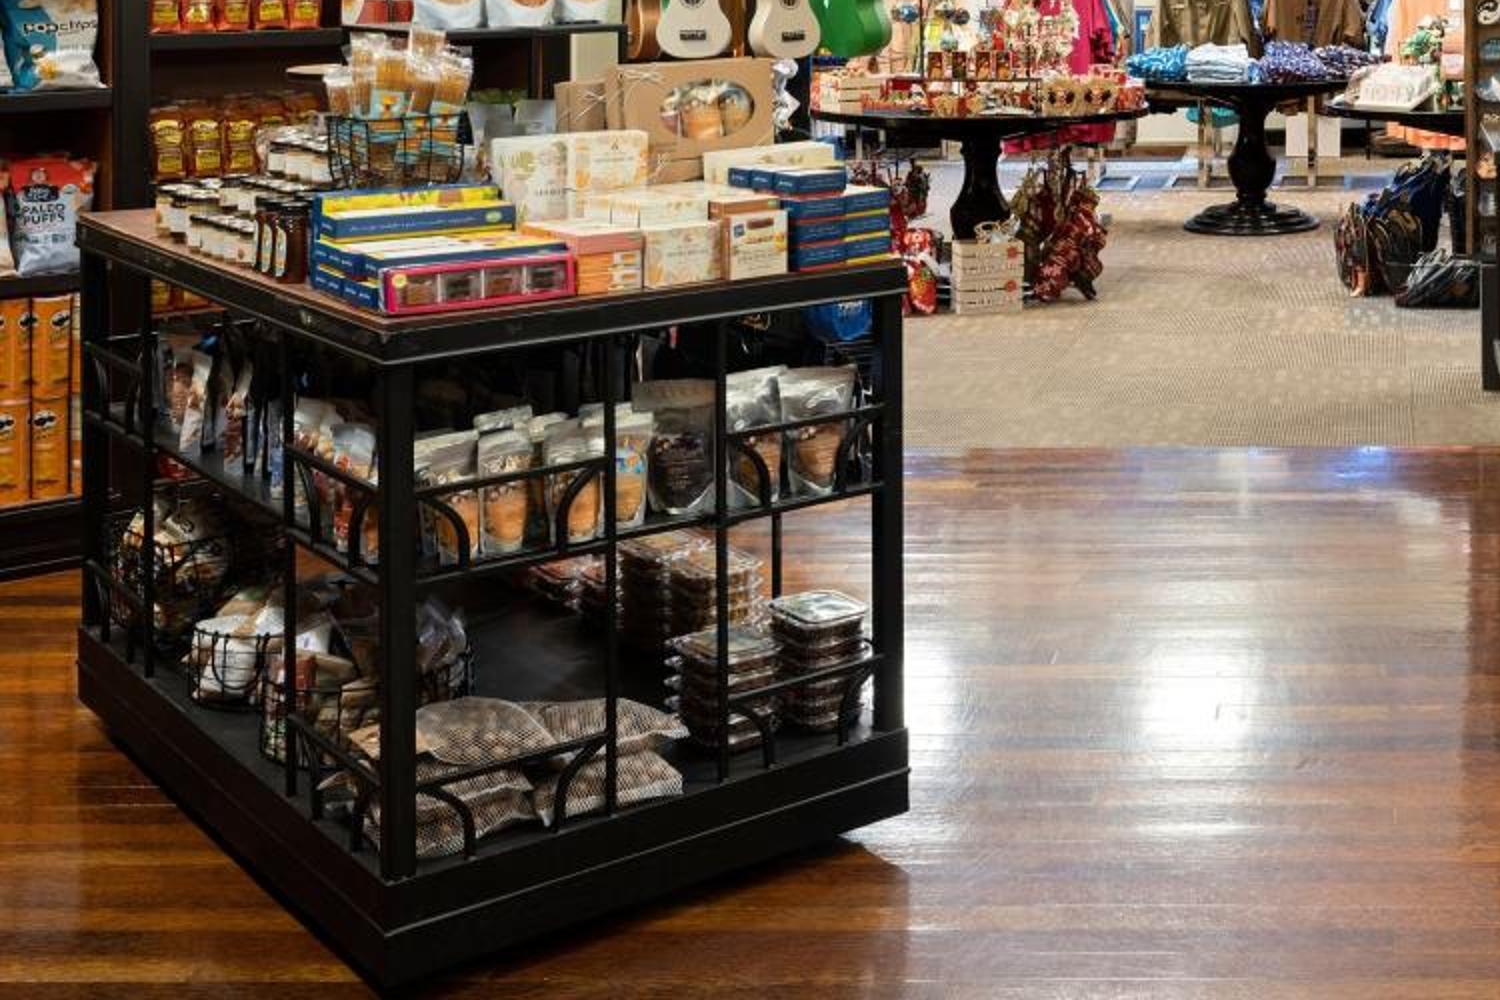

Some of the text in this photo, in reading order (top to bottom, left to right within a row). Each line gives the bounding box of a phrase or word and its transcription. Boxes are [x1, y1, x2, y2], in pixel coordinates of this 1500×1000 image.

[23, 20, 97, 34] popchips
[22, 203, 65, 215] PALEO
[23, 213, 65, 226] PUFFS
